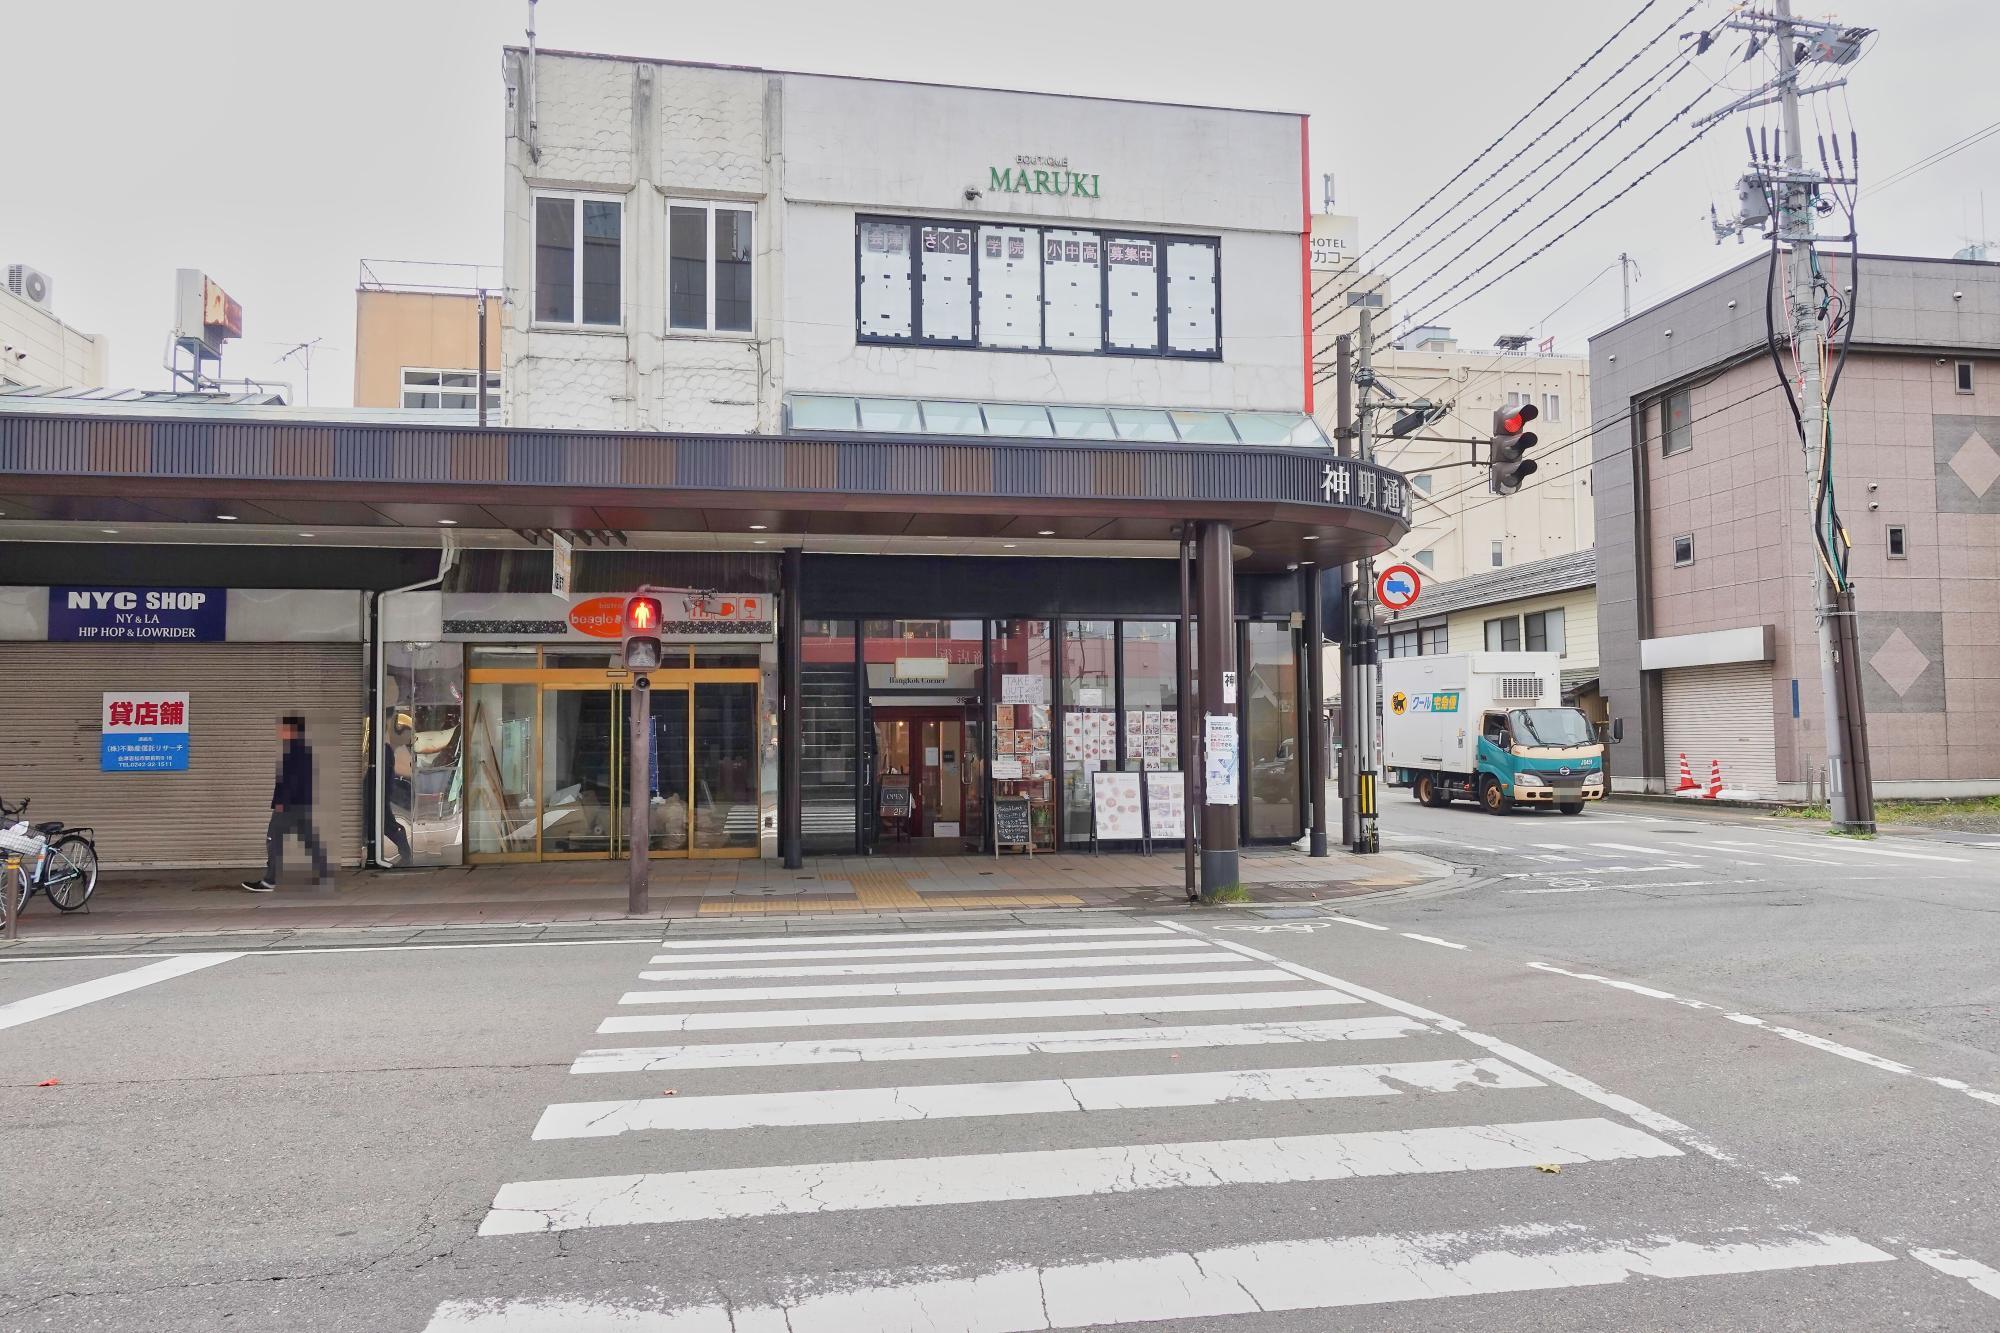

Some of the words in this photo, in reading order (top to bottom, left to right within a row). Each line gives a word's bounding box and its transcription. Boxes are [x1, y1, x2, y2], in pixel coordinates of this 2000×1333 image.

[989, 166, 1101, 198] MARUKI
[924, 233, 968, 253] さくら
[986, 238, 1025, 256] 学院
[1047, 241, 1097, 261] 小中高
[1109, 245, 1152, 263] 募集中
[1309, 238, 1346, 248] HOTEL
[1310, 250, 1354, 264] カコー
[68, 591, 137, 609] NYC
[146, 592, 206, 610] SHOP
[116, 614, 134, 624] NY
[135, 616, 142, 624] &
[144, 614, 160, 624] LA
[571, 613, 613, 625] beagle
[78, 627, 98, 637] HIP
[101, 627, 126, 637] HOP
[127, 629, 135, 637] &
[136, 627, 196, 638] LOWRIDER
[109, 701, 184, 726] 貸店舗
